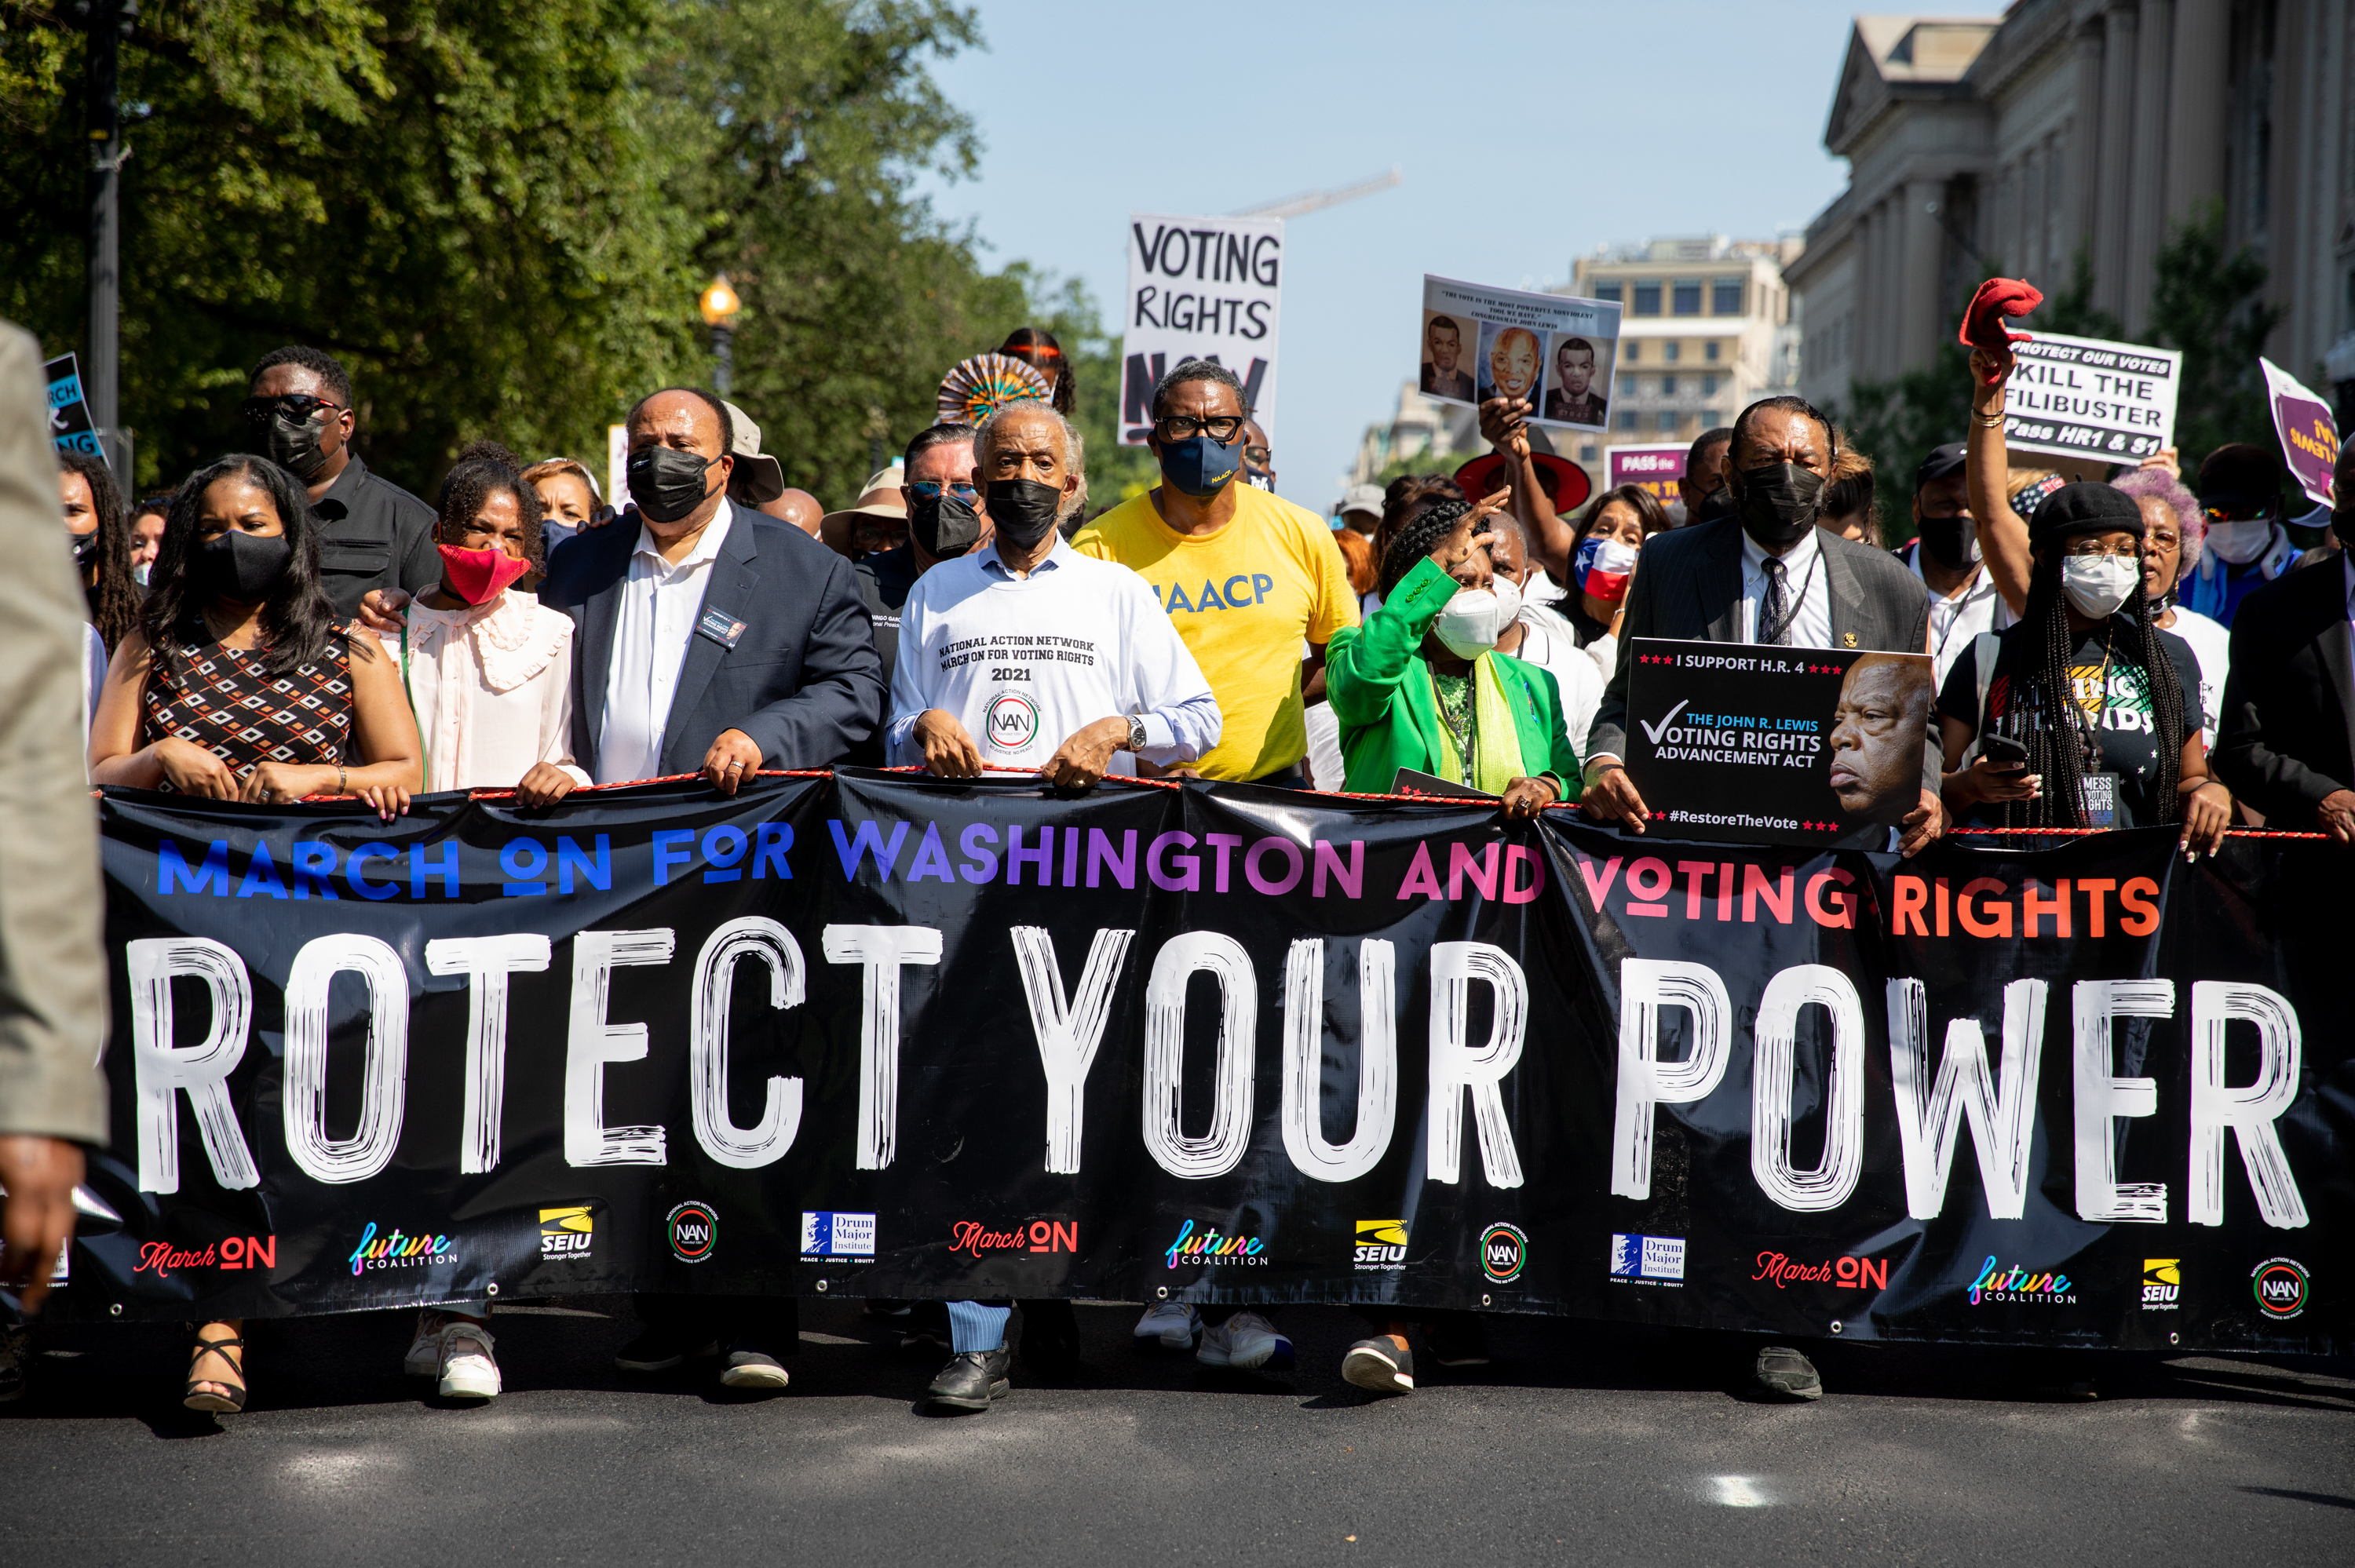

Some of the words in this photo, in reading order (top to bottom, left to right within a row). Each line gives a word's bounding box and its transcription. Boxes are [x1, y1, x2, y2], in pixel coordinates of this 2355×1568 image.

[1134, 223, 1280, 286] VOTING
[1135, 286, 1272, 339] RIGHTS
[1459, 294, 1474, 303] VOTE
[1484, 298, 1496, 307] THE
[1498, 301, 1515, 310] MOST
[1517, 304, 1551, 314] POWERFUL
[1553, 308, 1594, 319] NONVIOLENT
[1471, 311, 1517, 324] CONGRESSMAN
[1538, 321, 1558, 330] LEWIS
[2010, 341, 2082, 360] PROTECT
[2082, 350, 2117, 366] OUR
[2119, 356, 2169, 374] VOTES
[2015, 363, 2082, 389] KILL
[2094, 374, 2154, 400] THE
[47, 384, 77, 405] RCH
[2003, 418, 2055, 439] Pass
[2057, 425, 2105, 447] HR1
[2108, 434, 2127, 452] &
[2130, 436, 2160, 456] S1
[2290, 427, 2331, 463] LEWIS
[1622, 455, 1658, 472] PASS
[1658, 457, 1675, 470] the
[1211, 469, 1231, 483] NAACP
[940, 637, 987, 658] NATIONAL
[990, 636, 1033, 645] ACTION
[1036, 636, 1094, 651] NETWORK
[940, 652, 969, 673] MARCH
[971, 651, 984, 662] ON
[988, 649, 1008, 660] FOR
[1012, 649, 1053, 660] VOTING
[1057, 650, 1094, 665] RIGHTS
[1677, 655, 1681, 666] I
[1685, 655, 1757, 671] SUPPORT
[1761, 660, 1791, 673] H.R.
[1795, 662, 1804, 673] 4
[991, 668, 1031, 681] 2021
[982, 693, 1001, 713] NATIONAL
[1021, 691, 1042, 713] NETWORK
[992, 713, 1030, 731] NAN
[1687, 713, 1714, 725] THE
[1715, 715, 1755, 728] JOHN
[1759, 718, 1772, 729] R.
[1776, 719, 1819, 732] LEWIS
[1020, 744, 1034, 753] PEACE
[1743, 731, 1821, 753] RIGHTS
[1655, 746, 1780, 766] ADVANCEMENT
[1783, 755, 1816, 768] ACT
[2083, 777, 2112, 790] MESS
[1669, 810, 1798, 830] #RestoreTheVote
[158, 837, 462, 901] MARCH
[499, 833, 611, 896] ON
[652, 822, 794, 886] FOR
[827, 819, 1364, 900] WASHINGTON
[1395, 841, 1546, 904] AND
[1577, 853, 1858, 929] VOTING
[1891, 874, 2160, 939] RIGHTS
[126, 915, 943, 1194] ROTECT
[1010, 926, 1528, 1189] YOUR
[1611, 957, 2310, 1229] POWER
[666, 1203, 684, 1221] NATIONAL
[700, 1202, 719, 1221] NETWORK
[836, 1216, 873, 1227] Drum
[676, 1224, 708, 1241] NAN
[835, 1228, 872, 1241] Major
[948, 1220, 1025, 1258] March
[1029, 1220, 1078, 1253] ON
[1480, 1224, 1495, 1242] NATIONAL
[1510, 1224, 1529, 1244] NETWORK
[349, 1222, 451, 1276] future
[541, 1233, 592, 1253] SEIU
[834, 1242, 871, 1250] Institute
[1165, 1219, 1265, 1269] future
[1645, 1240, 1682, 1253] Drum
[133, 1242, 216, 1278] March
[220, 1235, 276, 1270] ON
[366, 1254, 458, 1270] COALITION
[542, 1253, 567, 1261] Stronger
[568, 1250, 591, 1260] Together
[700, 1252, 713, 1261] PEACE
[1181, 1255, 1268, 1266] COALITION
[1353, 1246, 1407, 1262] SEIU
[1487, 1245, 1517, 1263] NAN
[1645, 1252, 1681, 1264] Major
[1644, 1264, 1681, 1274] Institute
[1751, 1251, 1831, 1289] March
[1835, 1256, 1887, 1290] ON
[2250, 1260, 2270, 1278] NATIONAL
[2289, 1260, 2311, 1278] NETWORK
[1967, 1255, 2072, 1305] future
[2262, 1280, 2299, 1298] NAN
[1984, 1292, 2076, 1304] COALITION
[2141, 1285, 2179, 1302] SEIU
[2142, 1303, 2159, 1311] Stronger
[2159, 1303, 2179, 1311] Together
